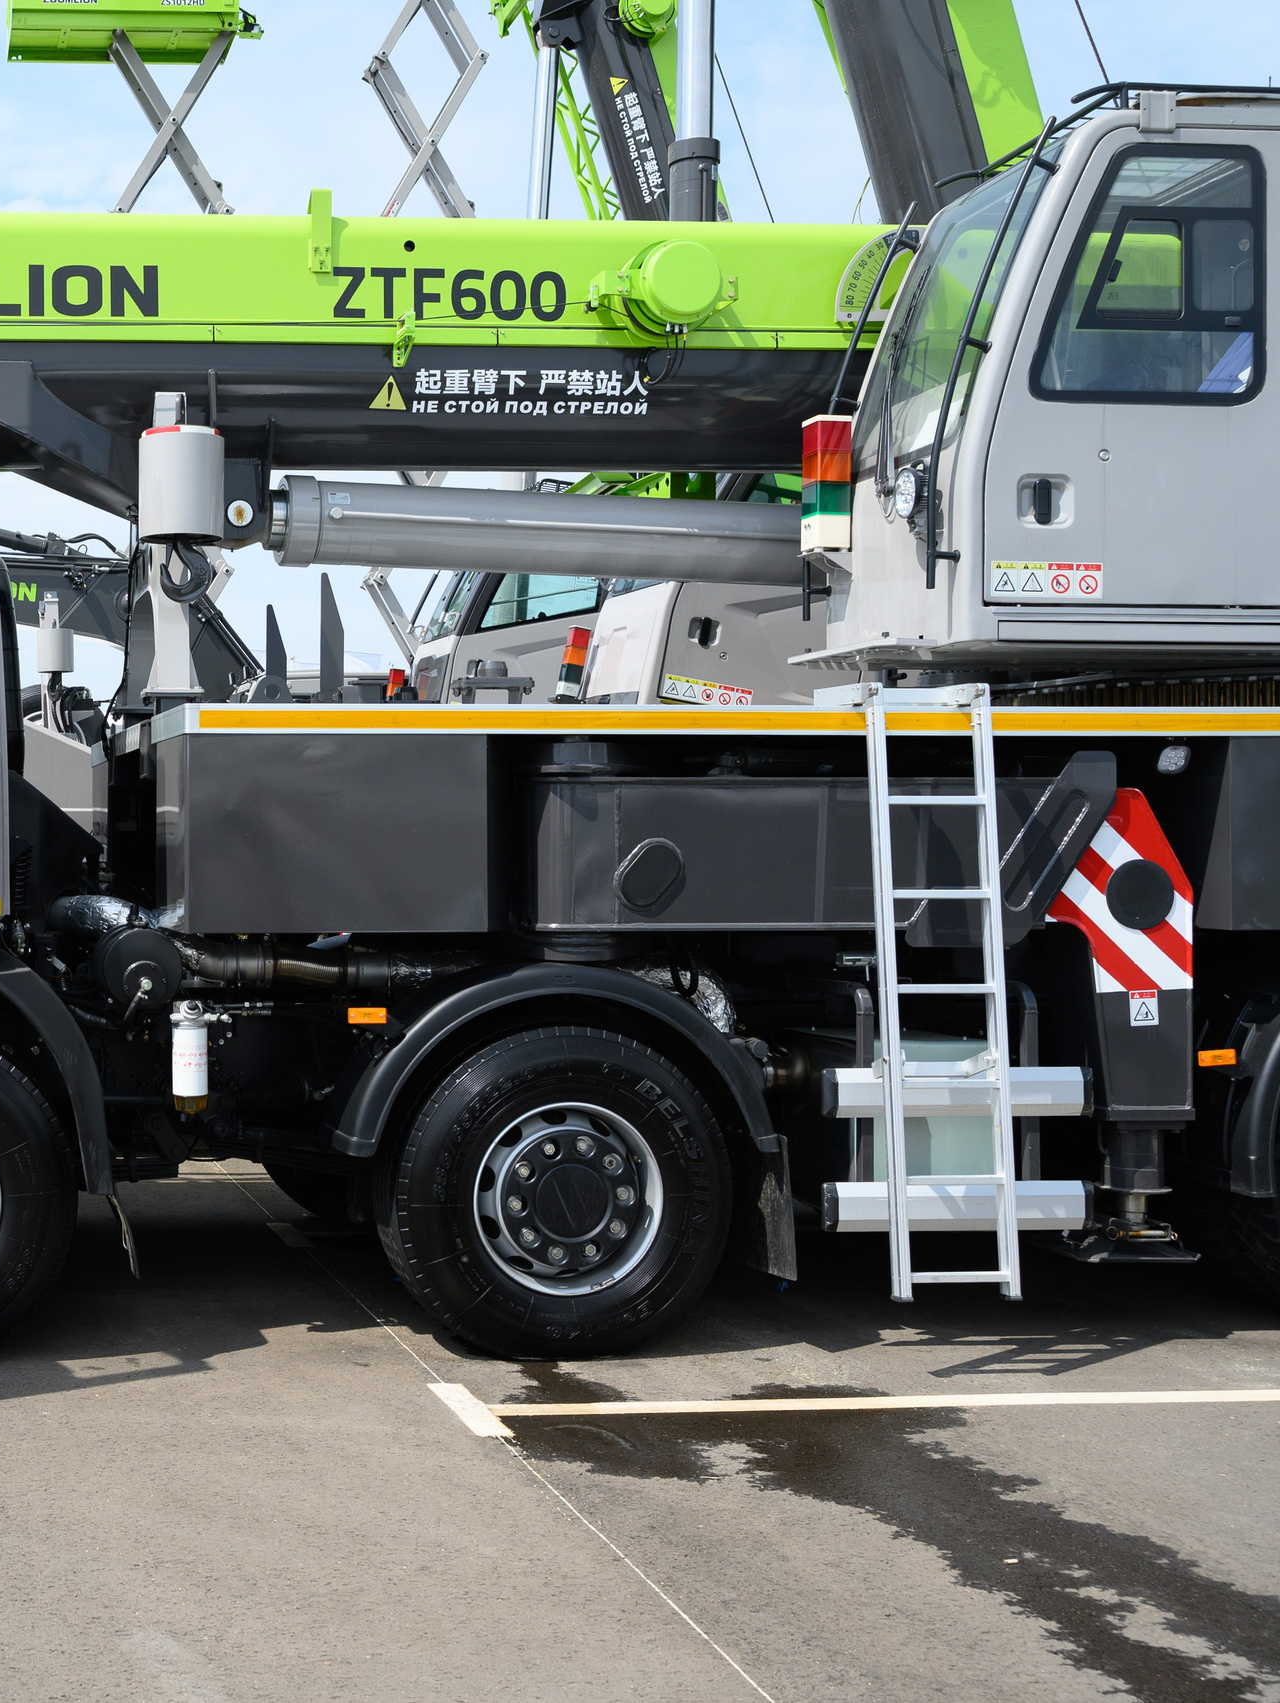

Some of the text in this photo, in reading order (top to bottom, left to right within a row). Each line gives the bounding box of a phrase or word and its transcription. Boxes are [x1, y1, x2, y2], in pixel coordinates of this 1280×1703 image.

[614, 96, 653, 204] НЕ СТОЙ ПОД СТРЕЛОЙ
[875, 241, 884, 251] 30
[866, 249, 875, 260] 40
[858, 259, 868, 270] 50
[851, 270, 862, 281] 60
[847, 282, 858, 293] 70
[332, 266, 567, 322] ZTF600
[845, 294, 855, 306] 80
[414, 368, 650, 397] 起重臂下 严禁站人
[412, 398, 649, 416] НЕ СТОЙ ПОД СТРЕЛОЙ
[634, 1077, 712, 1256] BELSHINA
